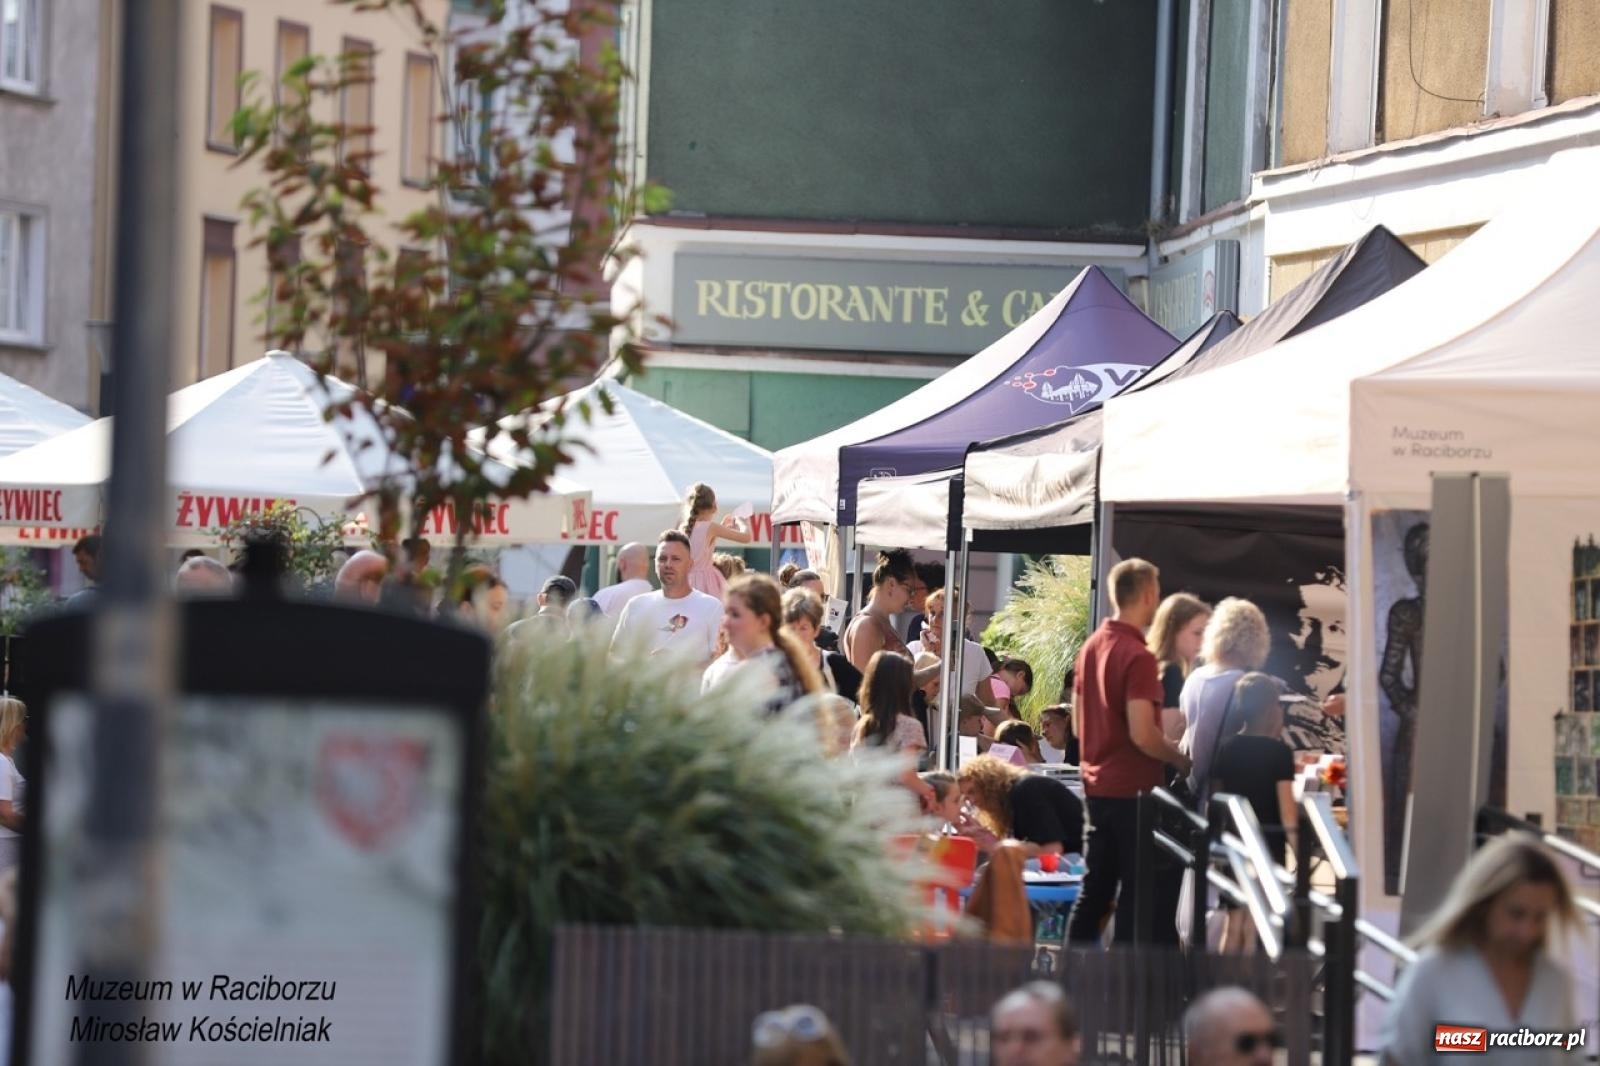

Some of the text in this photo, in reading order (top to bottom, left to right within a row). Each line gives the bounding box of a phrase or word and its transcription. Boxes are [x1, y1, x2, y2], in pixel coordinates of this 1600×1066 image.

[695, 279, 1058, 329] RISTORANTE & CA
[1392, 425, 1465, 441] Muzeum
[1392, 442, 1493, 459] w Raciborzu
[0, 489, 62, 522] YWIEC
